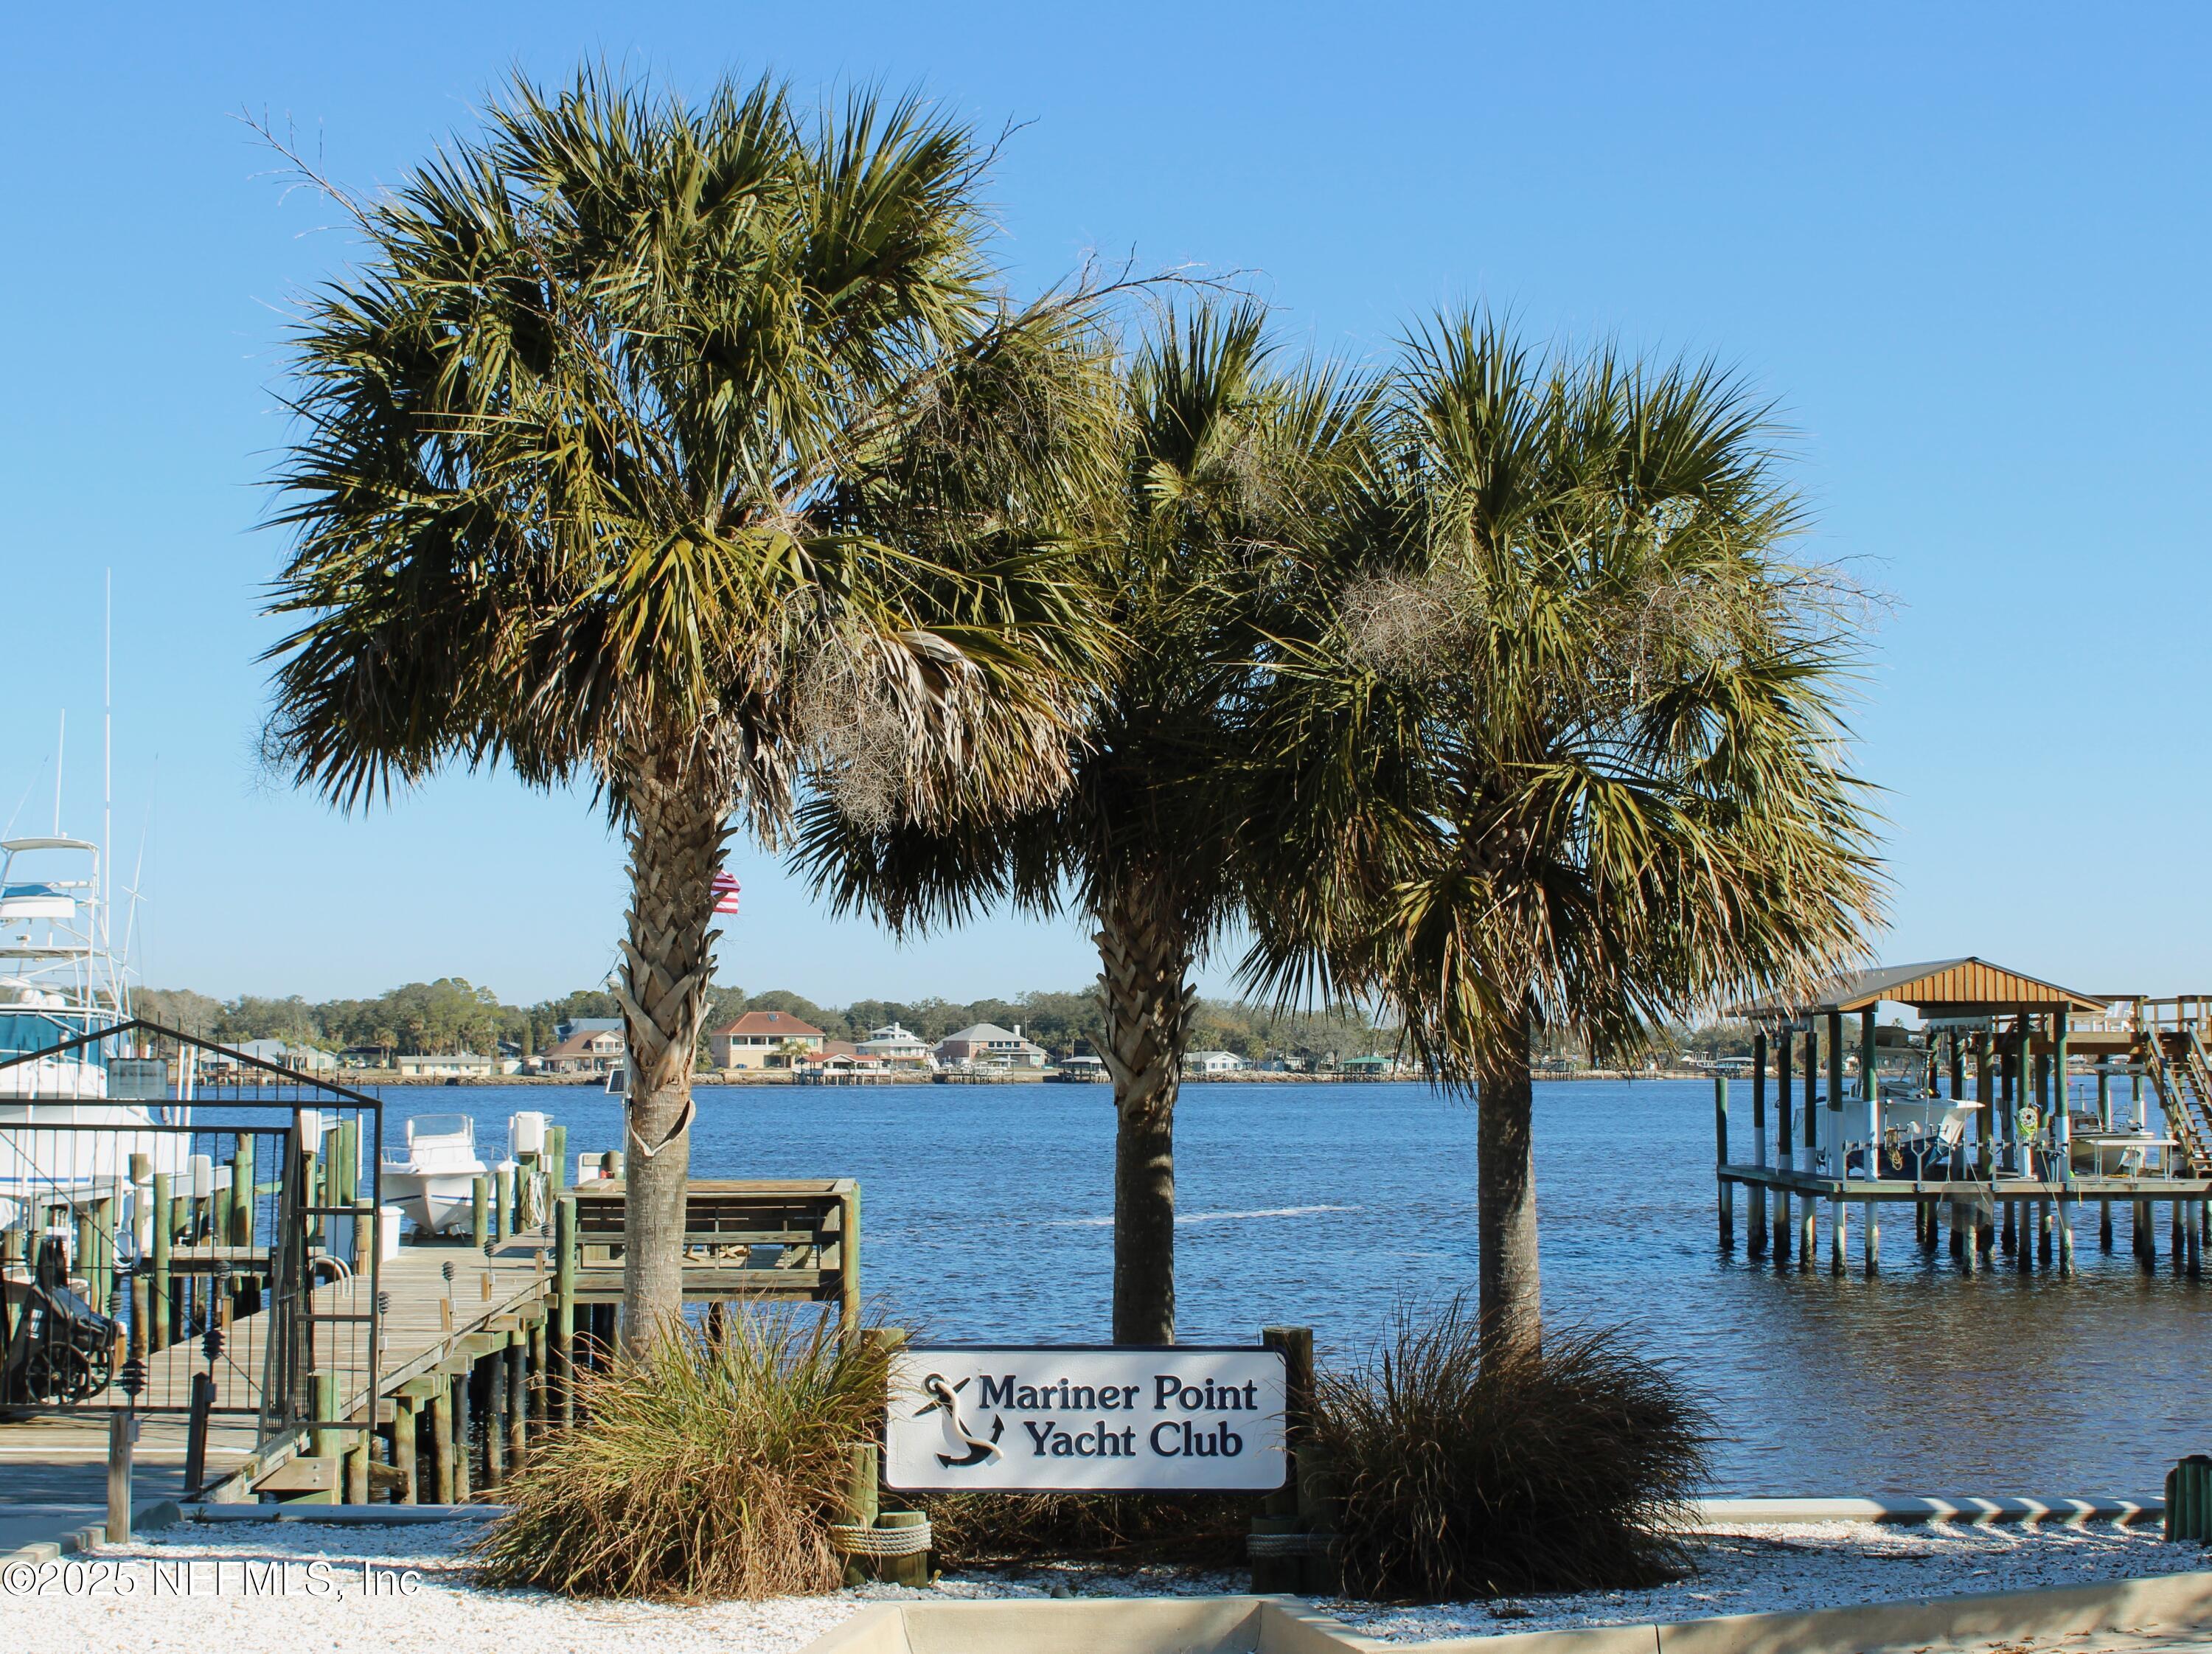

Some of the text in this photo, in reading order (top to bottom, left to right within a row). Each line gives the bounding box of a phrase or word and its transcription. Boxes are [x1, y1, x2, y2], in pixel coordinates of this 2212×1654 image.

[979, 1375, 1258, 1410] Mariner Point
[1023, 1420, 1243, 1457] Yacht Club
